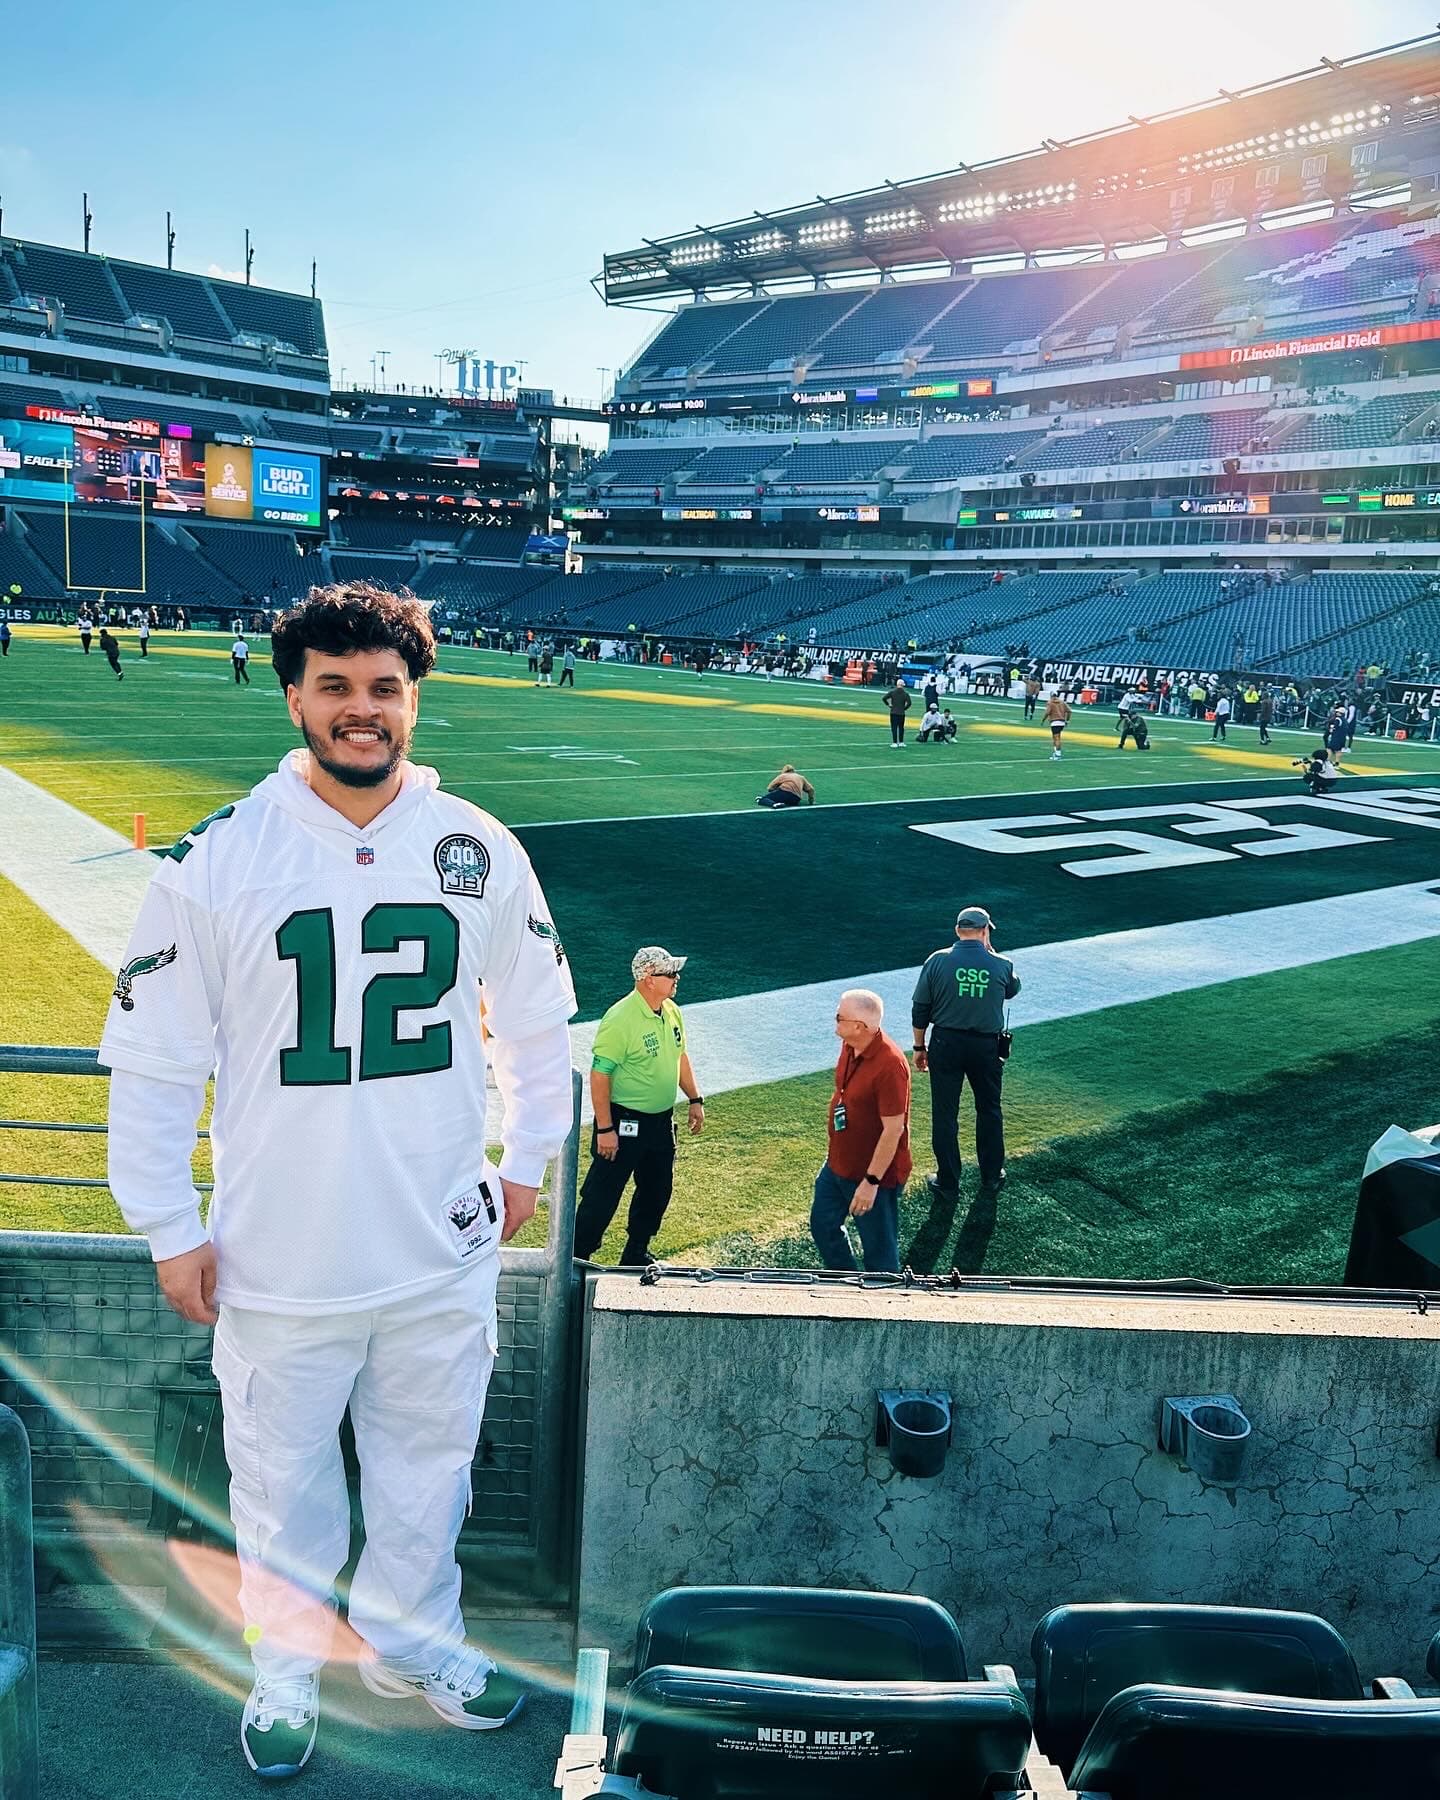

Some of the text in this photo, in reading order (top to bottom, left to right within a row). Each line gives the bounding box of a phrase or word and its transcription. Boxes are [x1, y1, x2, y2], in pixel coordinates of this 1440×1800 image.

[1243, 331, 1381, 362] Lincoln Financial Field
[442, 348, 478, 365] Miller
[455, 357, 517, 397] Lite
[620, 404, 626, 412] 0
[630, 403, 636, 412] 0
[51, 411, 93, 427] Lincoln
[24, 455, 73, 469] EAGLES
[270, 467, 304, 483] BUD
[263, 479, 310, 497] LIGHT
[1384, 494, 1415, 507] HOME
[264, 510, 309, 522] GO BIRDS
[1042, 663, 1149, 685] PHILADELPHIA
[955, 968, 990, 984] CSC
[275, 902, 460, 1087] 12
[959, 983, 988, 998] FIT
[757, 1727, 875, 1745] NEED HELP?
